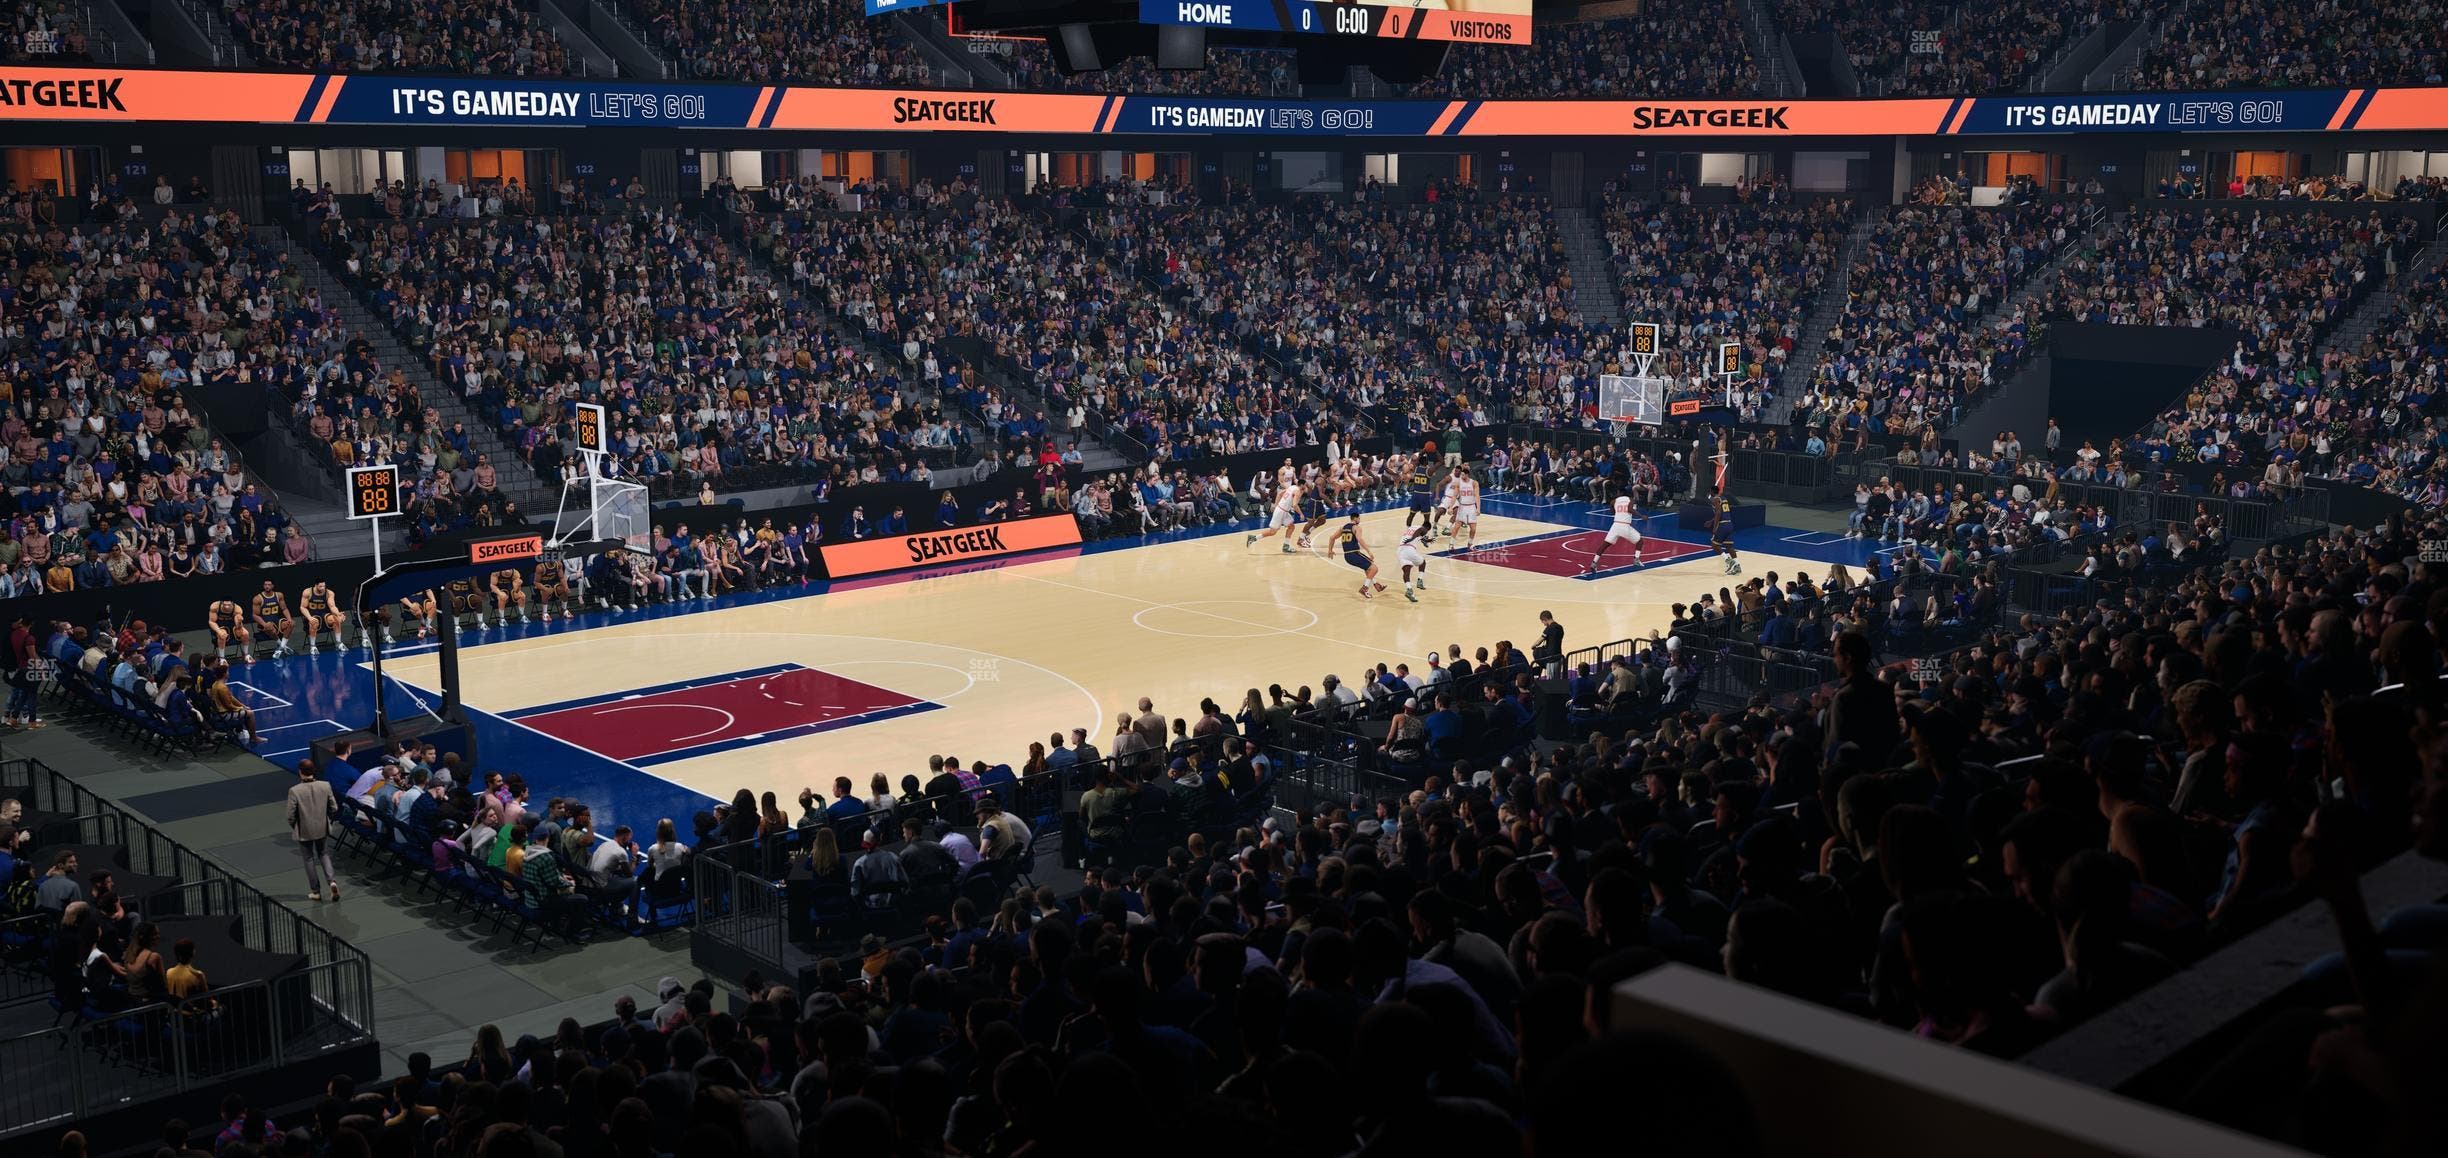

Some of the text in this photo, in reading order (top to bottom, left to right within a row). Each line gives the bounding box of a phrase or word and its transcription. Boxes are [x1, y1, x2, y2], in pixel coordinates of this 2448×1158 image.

[1179, 3, 1511, 39] HOME 0 0:00 0 VISITORS
[392, 89, 704, 119] IT'S GAMEDAY LET'S GO!
[894, 98, 996, 124] SEATGEEK
[2006, 101, 2283, 126] IT'S GAMEDAY LET'S GO!
[1152, 107, 1372, 129] IT'S GAMEDAY LET'S GO!
[1633, 107, 1789, 129] SEATGEEK
[125, 165, 146, 175] 121
[266, 165, 288, 174] 122
[576, 165, 594, 174] 122
[682, 165, 698, 173] 123
[1637, 337, 1650, 351] 88
[582, 424, 595, 445] 88
[358, 471, 390, 487] 88 88
[363, 488, 388, 512] 88
[479, 540, 535, 559] SEATGEEK
[907, 526, 1007, 562] SEATGEEK
[262, 606, 278, 615] 00
